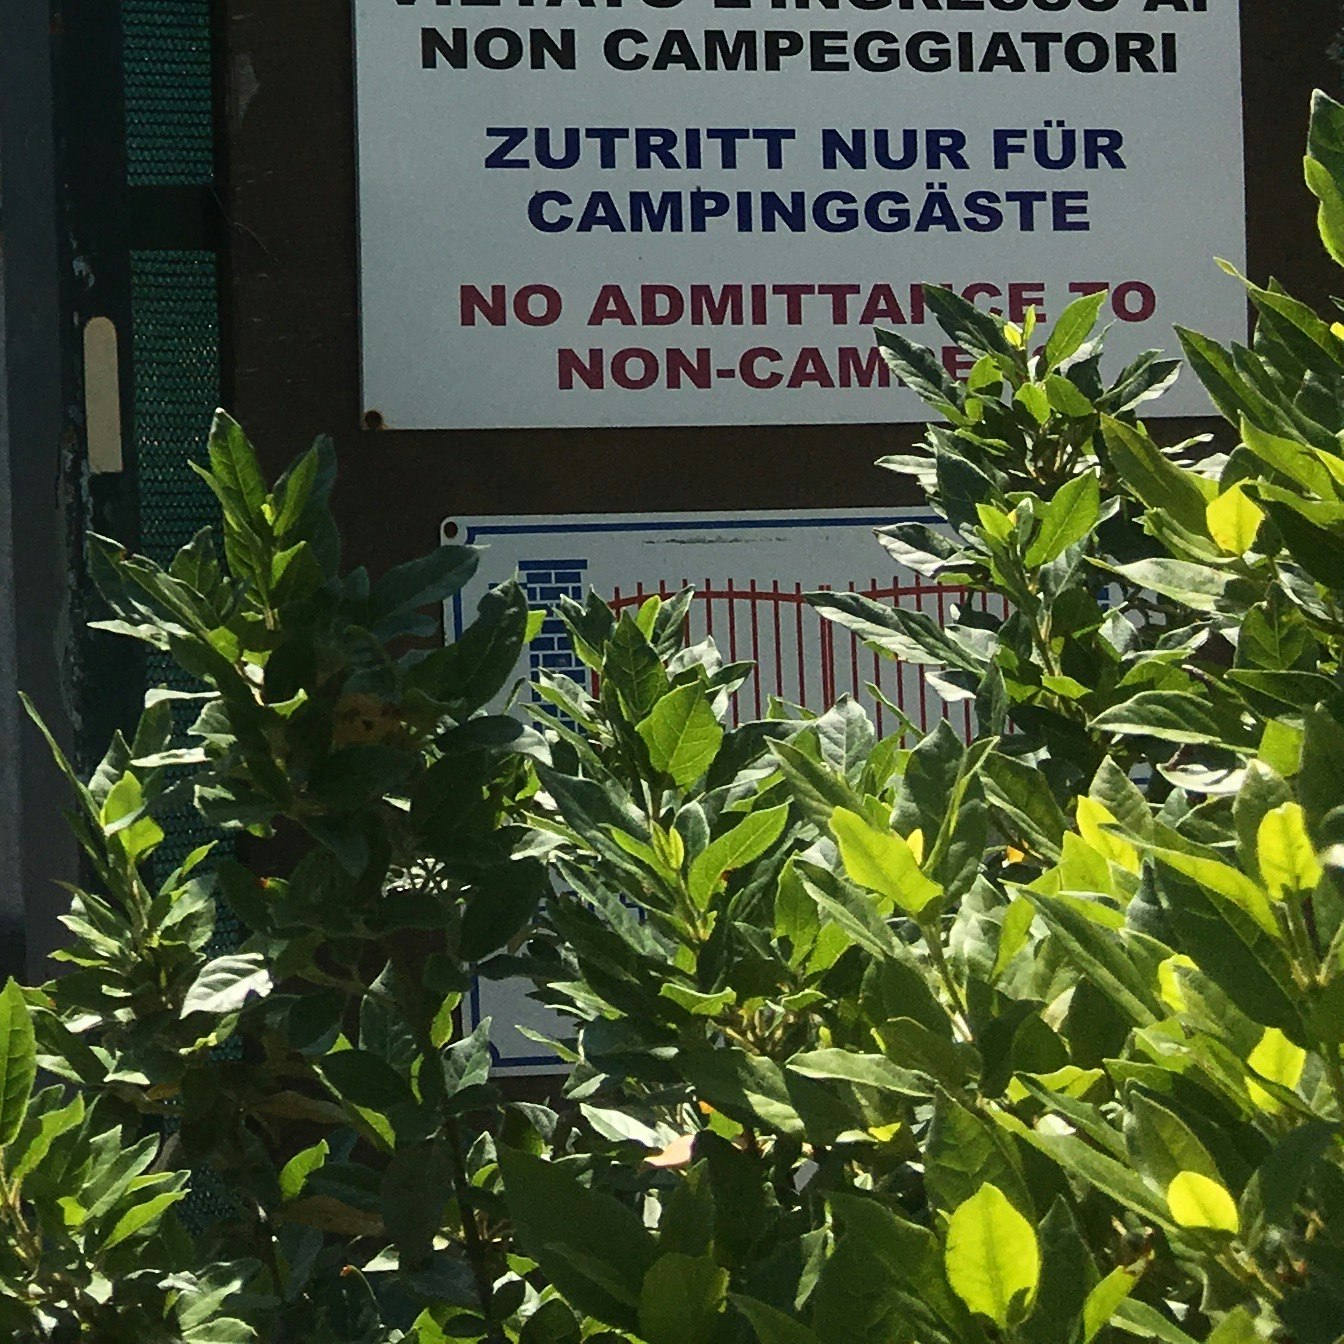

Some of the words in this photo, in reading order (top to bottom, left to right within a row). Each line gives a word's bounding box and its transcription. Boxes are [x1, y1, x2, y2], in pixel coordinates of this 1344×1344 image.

[420, 26, 577, 71] NON
[603, 28, 1178, 74] CAMPEGGIATORI
[484, 126, 797, 171] ZUTRITT
[821, 128, 971, 171] NUR
[992, 120, 1127, 171] FÜR
[526, 181, 1091, 234] CAMPINGGÄSTE
[459, 283, 563, 327] NO
[556, 344, 1047, 391] NON-CAME
